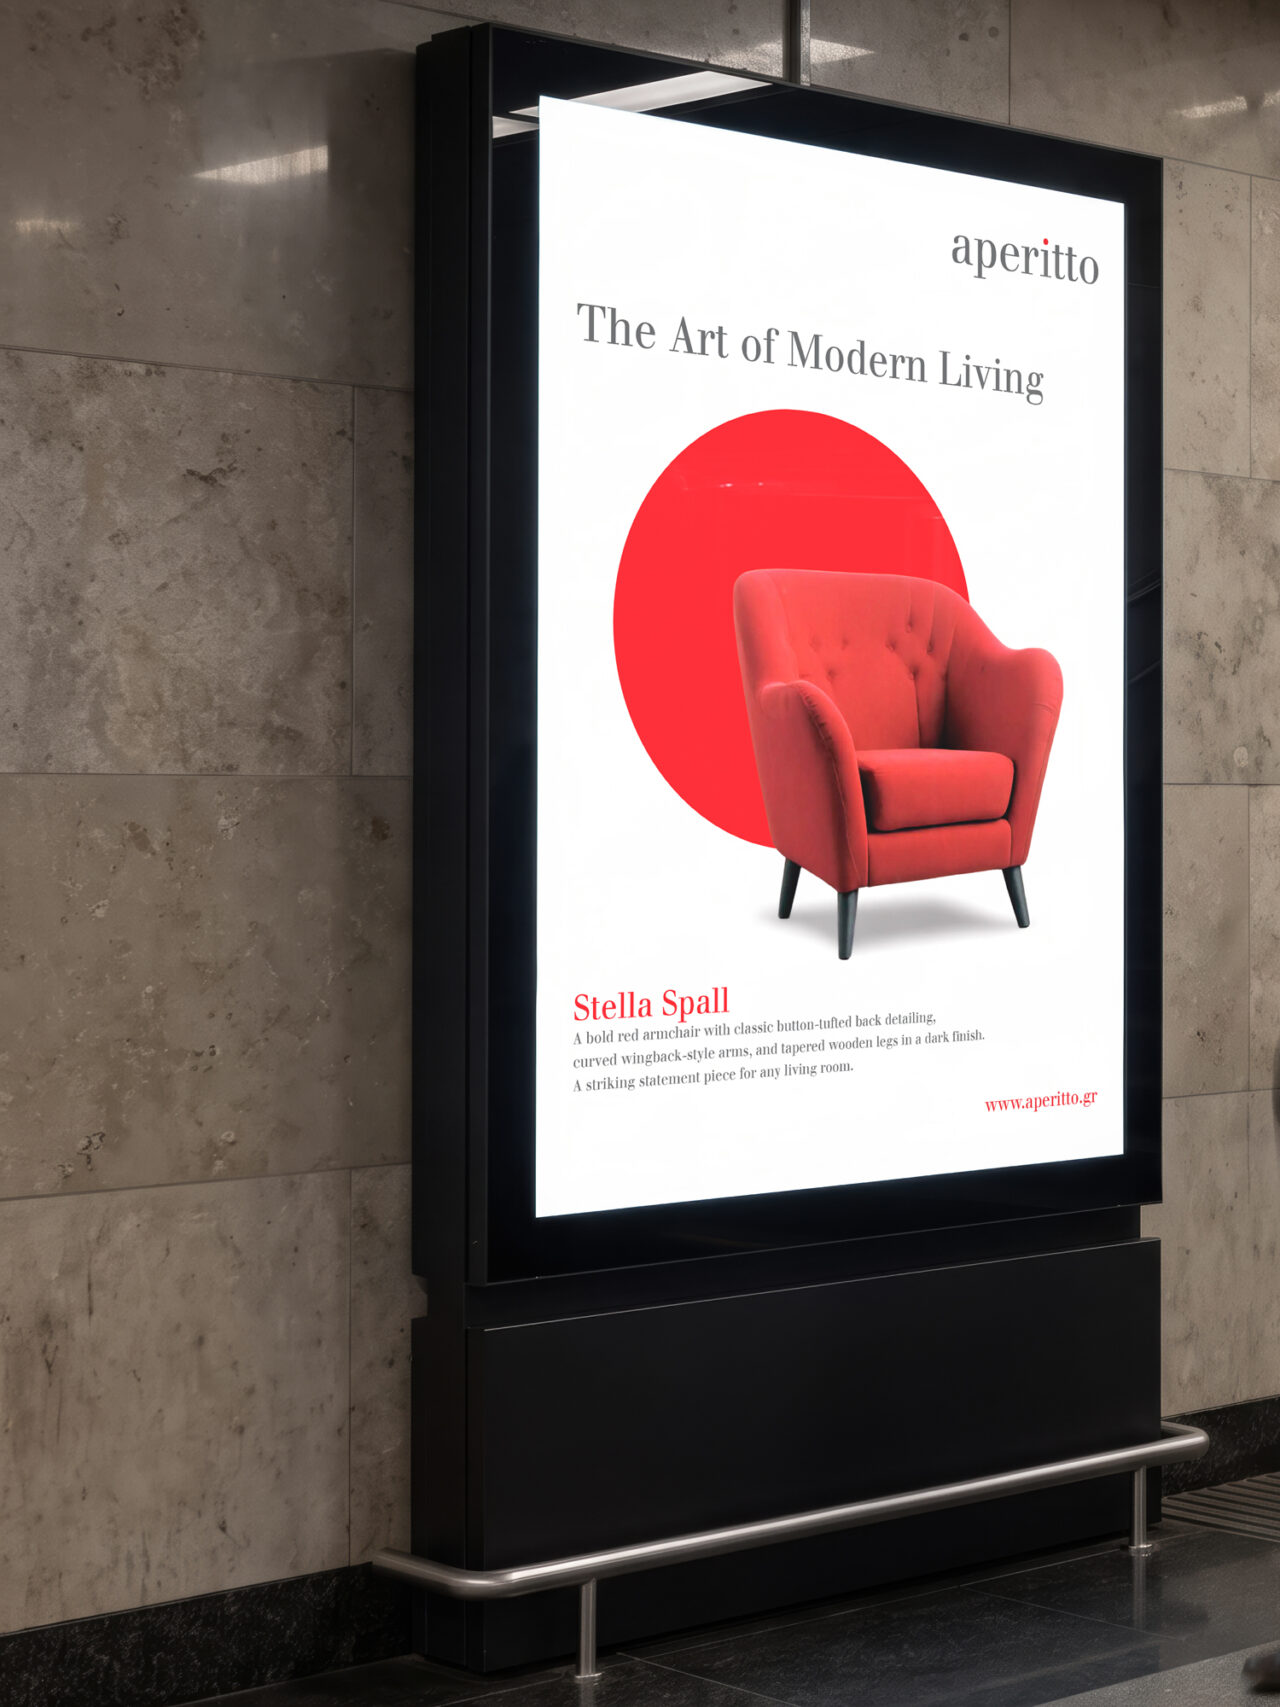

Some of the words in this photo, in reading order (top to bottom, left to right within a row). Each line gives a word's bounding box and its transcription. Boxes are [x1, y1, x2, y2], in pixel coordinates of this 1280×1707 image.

[952, 235, 1100, 285] aperitto
[577, 303, 656, 350] The
[669, 316, 729, 359] Art
[742, 328, 780, 365] of
[786, 331, 929, 383] Modern
[939, 351, 1045, 406] Living
[574, 992, 653, 1021] Stella
[662, 987, 730, 1023] Spall
[574, 1033, 582, 1045] A
[587, 1030, 613, 1044] bold
[618, 1028, 638, 1042] red
[643, 1025, 700, 1040] armchair
[704, 1023, 730, 1036] with
[734, 1021, 773, 1035] classic
[777, 1016, 851, 1032] button-tufted
[856, 1014, 882, 1027] back
[885, 1012, 936, 1025] detailing,
[573, 1053, 616, 1068] curved
[622, 1047, 715, 1066] wingback-style
[719, 1047, 752, 1059] arms,
[756, 1043, 777, 1055] and
[781, 1039, 825, 1056] tapered
[829, 1037, 872, 1050] wooden
[877, 1036, 898, 1049] legs
[902, 1035, 912, 1045] in
[915, 1036, 921, 1045] a
[925, 1031, 949, 1044] dark
[953, 1029, 984, 1042] finish.
[574, 1080, 582, 1092] A
[586, 1077, 635, 1091] striking
[639, 1072, 699, 1087] statement
[704, 1070, 736, 1085] piece
[740, 1067, 757, 1079] for
[760, 1067, 780, 1080] any
[785, 1063, 817, 1077] living
[821, 1062, 853, 1073] room.
[985, 1091, 1098, 1112] www.aperitto.gr
